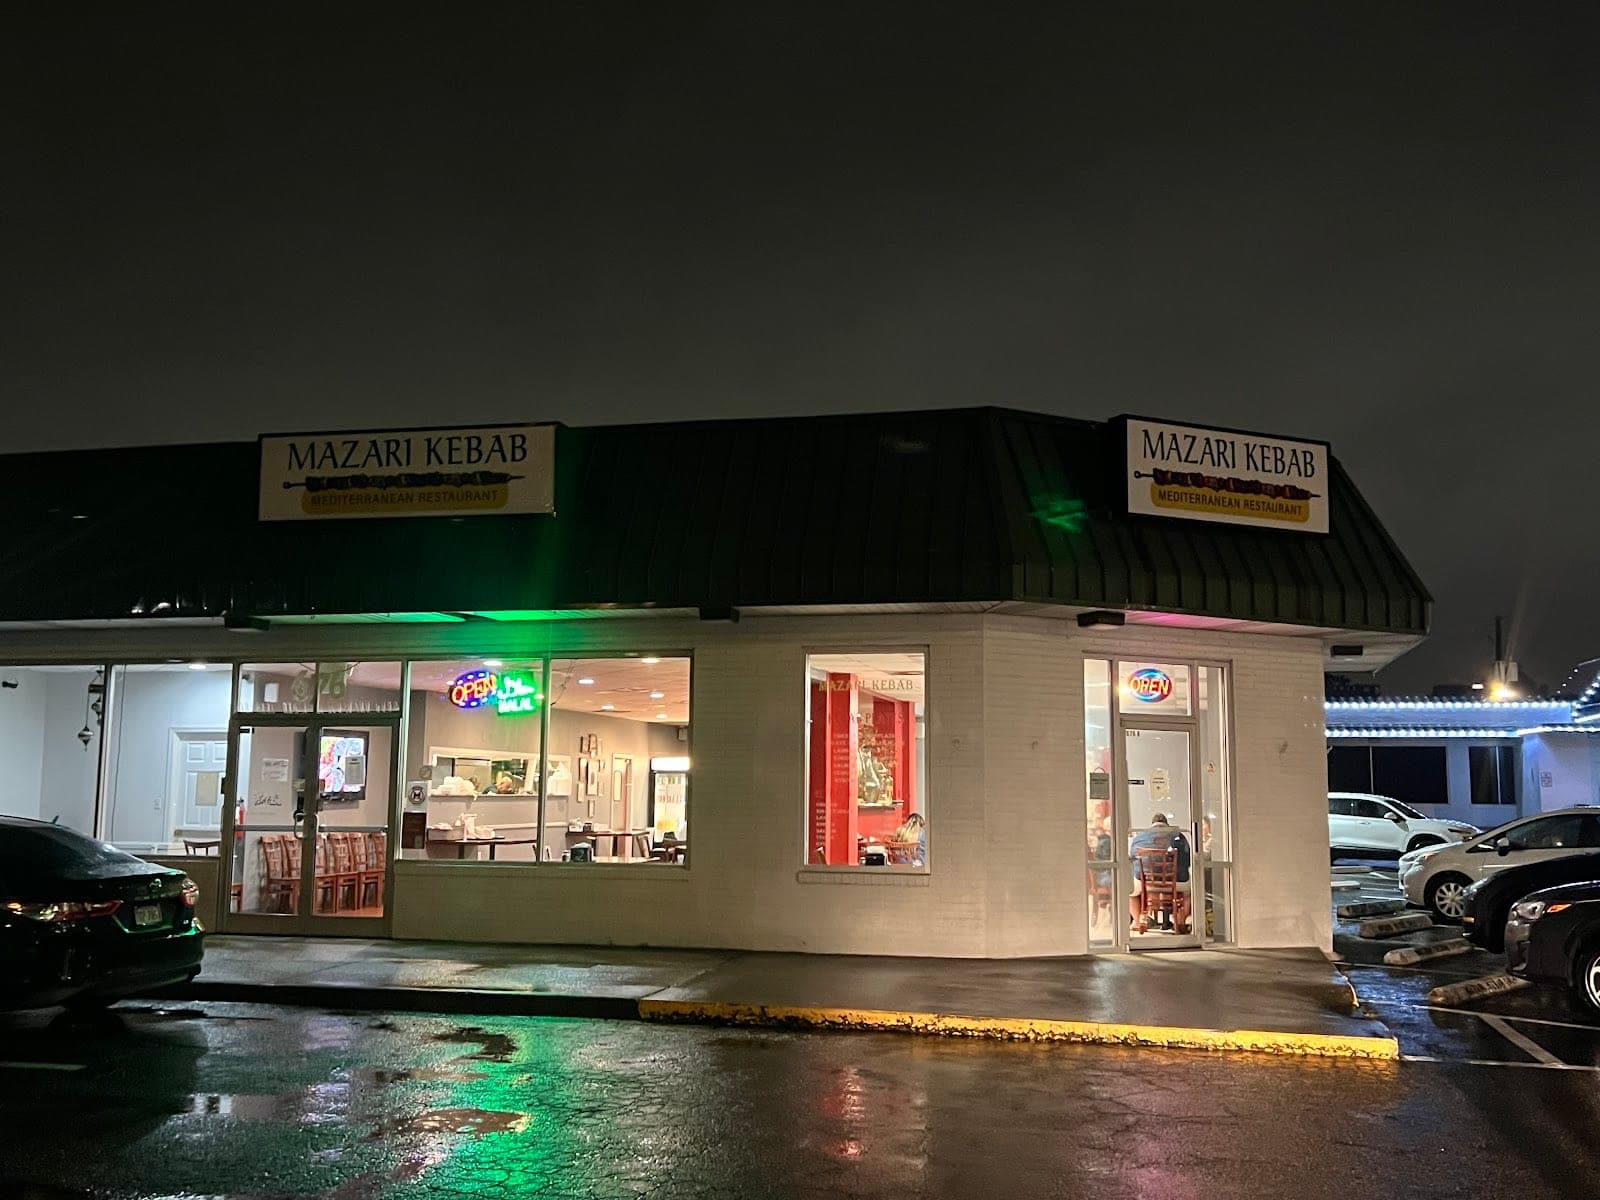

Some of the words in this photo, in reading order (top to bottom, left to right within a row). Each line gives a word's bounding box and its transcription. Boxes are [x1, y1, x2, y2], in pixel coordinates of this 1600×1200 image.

[287, 437, 412, 471] MAZARI
[423, 433, 528, 466] KEBAB
[1142, 429, 1236, 469] MAZARI
[1244, 442, 1315, 478] KEBAB
[310, 491, 414, 508] MEDITERRANEAN
[418, 489, 499, 504] RESTAURANT
[1158, 489, 1241, 508] MEDITERRANEAN
[1243, 499, 1302, 516] RESTAURANT
[451, 673, 497, 704] OPEN
[818, 679, 867, 692] MAZARI
[872, 679, 914, 691] KEBAB
[1130, 677, 1169, 695] OPEN
